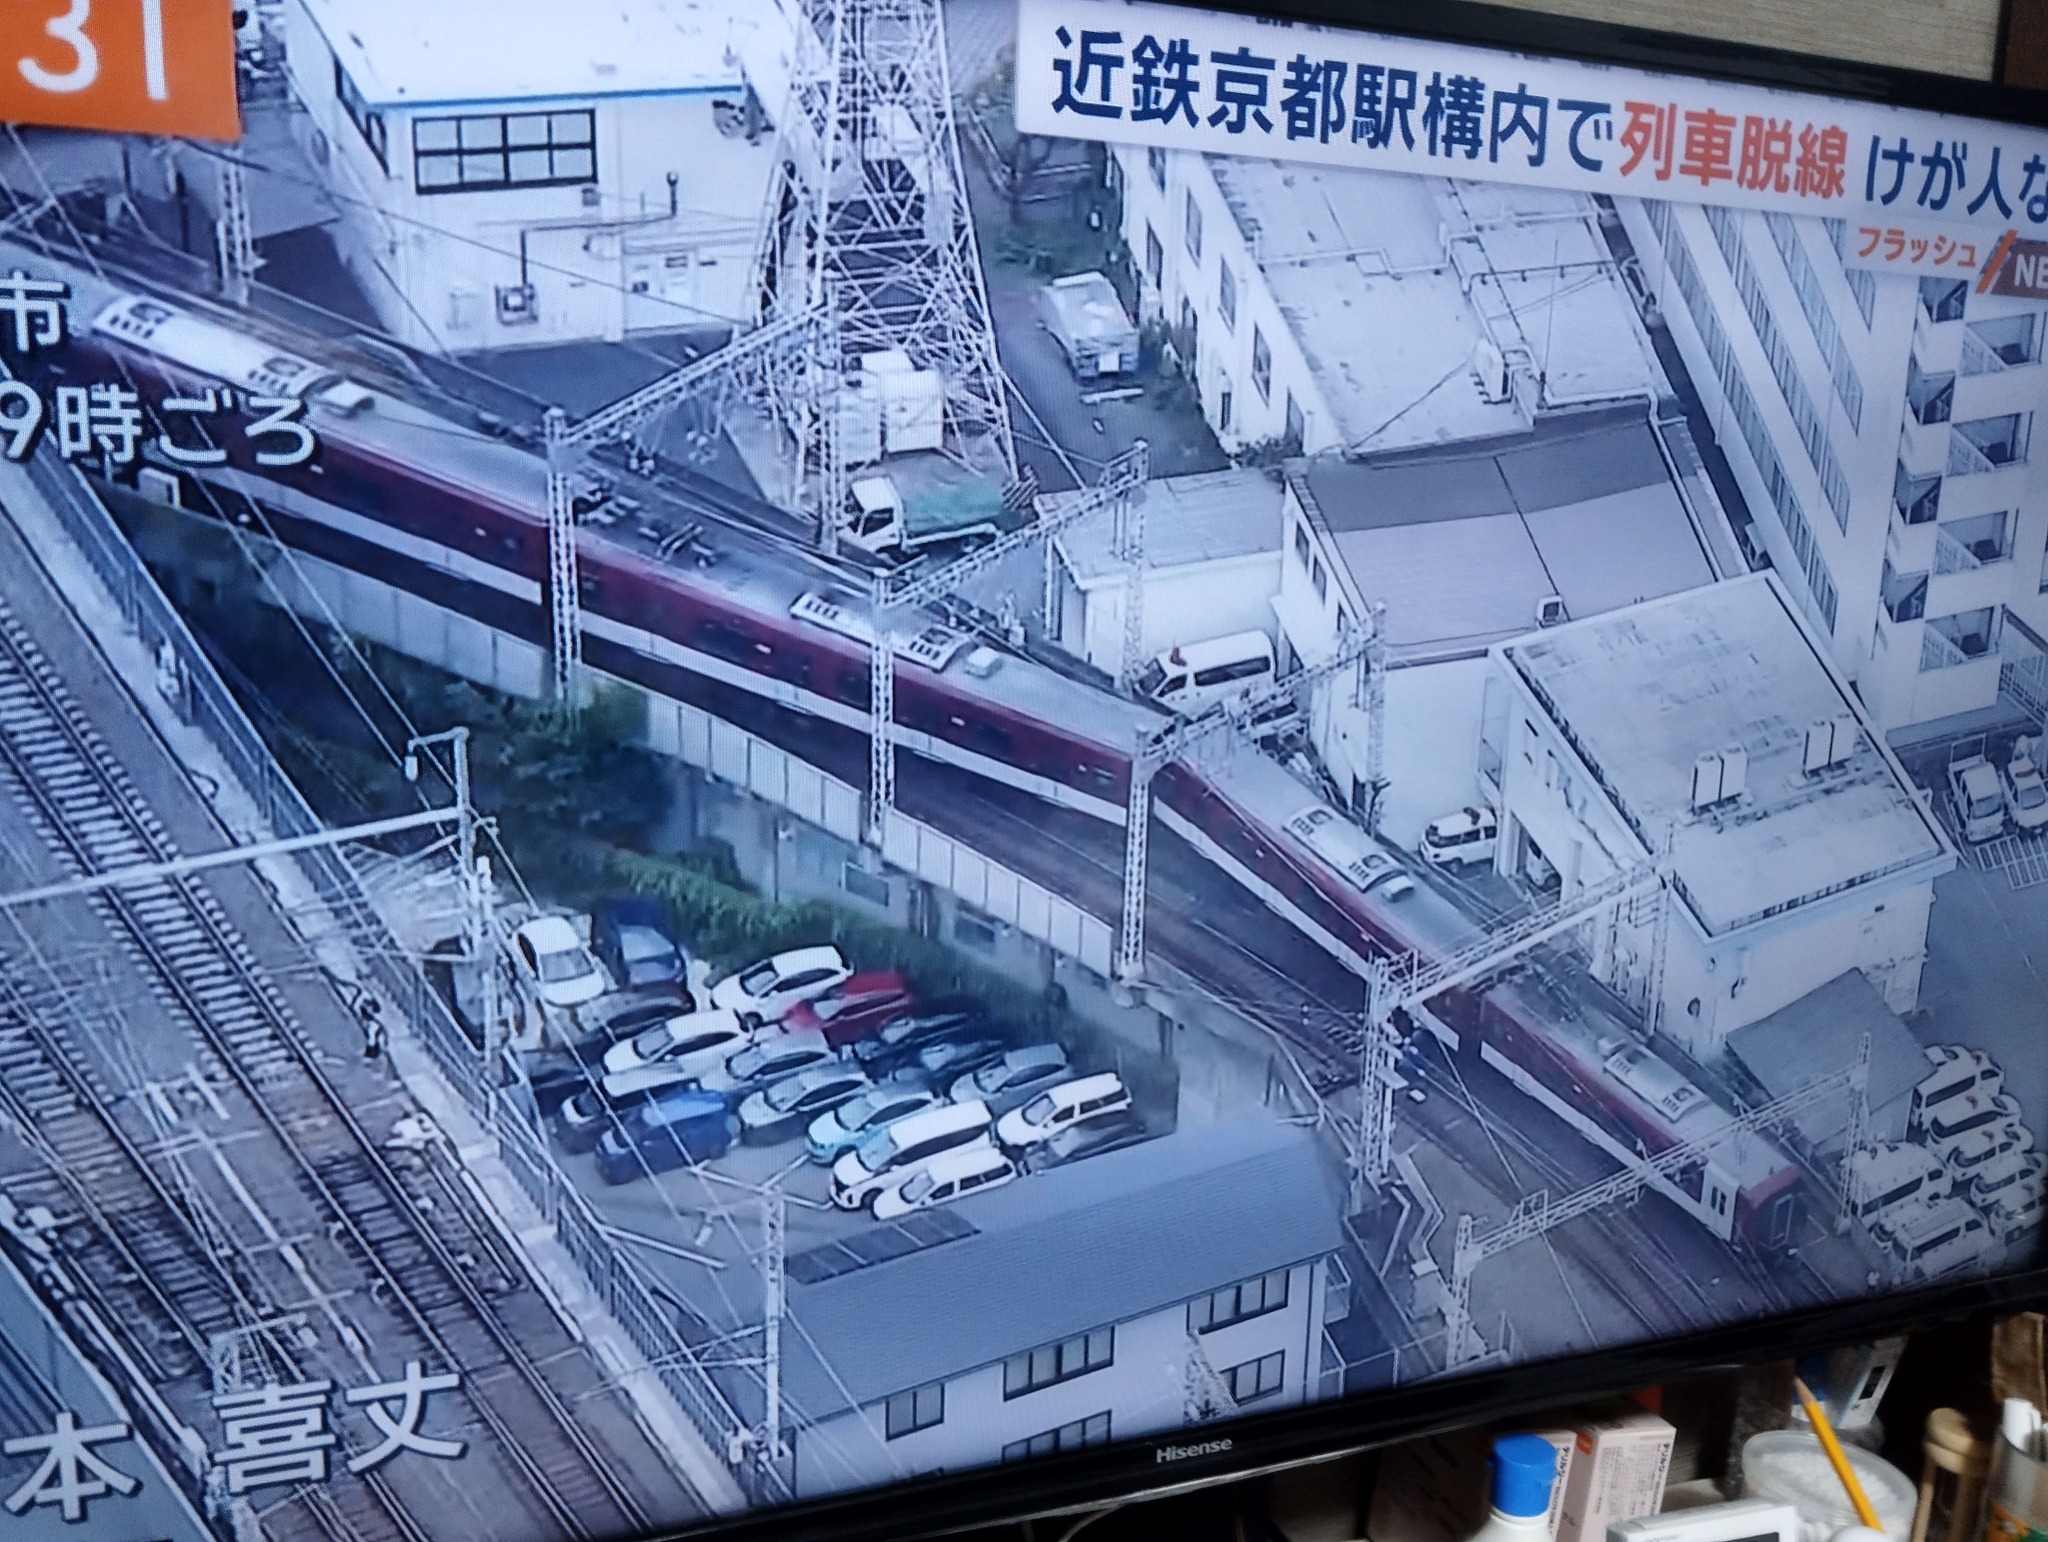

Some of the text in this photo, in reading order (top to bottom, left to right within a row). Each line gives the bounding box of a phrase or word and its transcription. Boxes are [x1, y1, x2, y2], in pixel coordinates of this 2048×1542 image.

[18, 0, 169, 101] 31
[1858, 226, 1977, 269] フラッシュ
[0, 271, 65, 352] 市
[0, 380, 315, 466] 9時ごろ
[1156, 1438, 1233, 1463] Hisense
